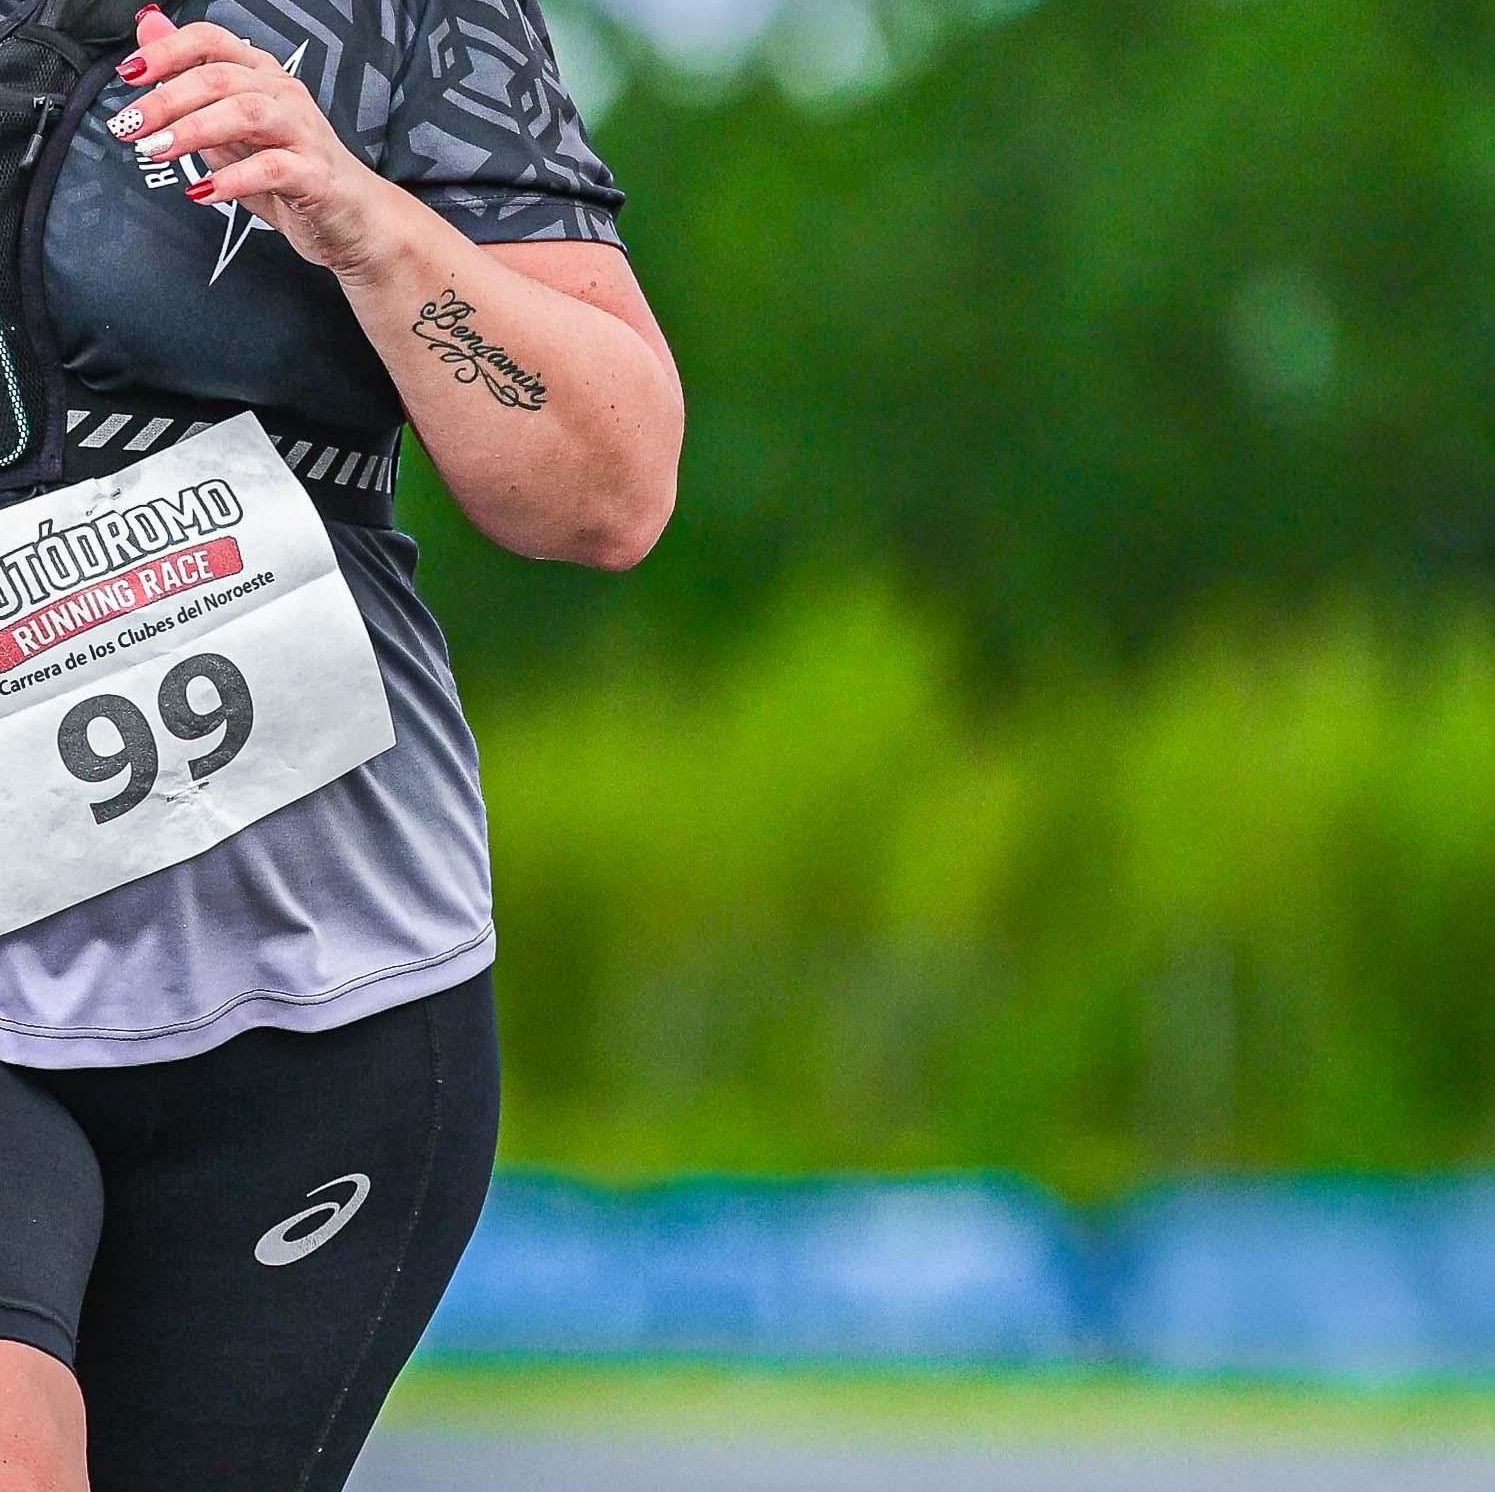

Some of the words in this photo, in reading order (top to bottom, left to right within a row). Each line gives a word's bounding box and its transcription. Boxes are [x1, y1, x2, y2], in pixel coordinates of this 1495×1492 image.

[136, 151, 179, 189] RU
[11, 580, 136, 657] RUNNING
[136, 550, 214, 600] RACE
[65, 650, 88, 671] de
[89, 639, 116, 661] los
[118, 615, 175, 649] Clubes
[176, 599, 203, 626] del
[203, 569, 275, 612] Noroeste
[56, 651, 255, 825] 99
